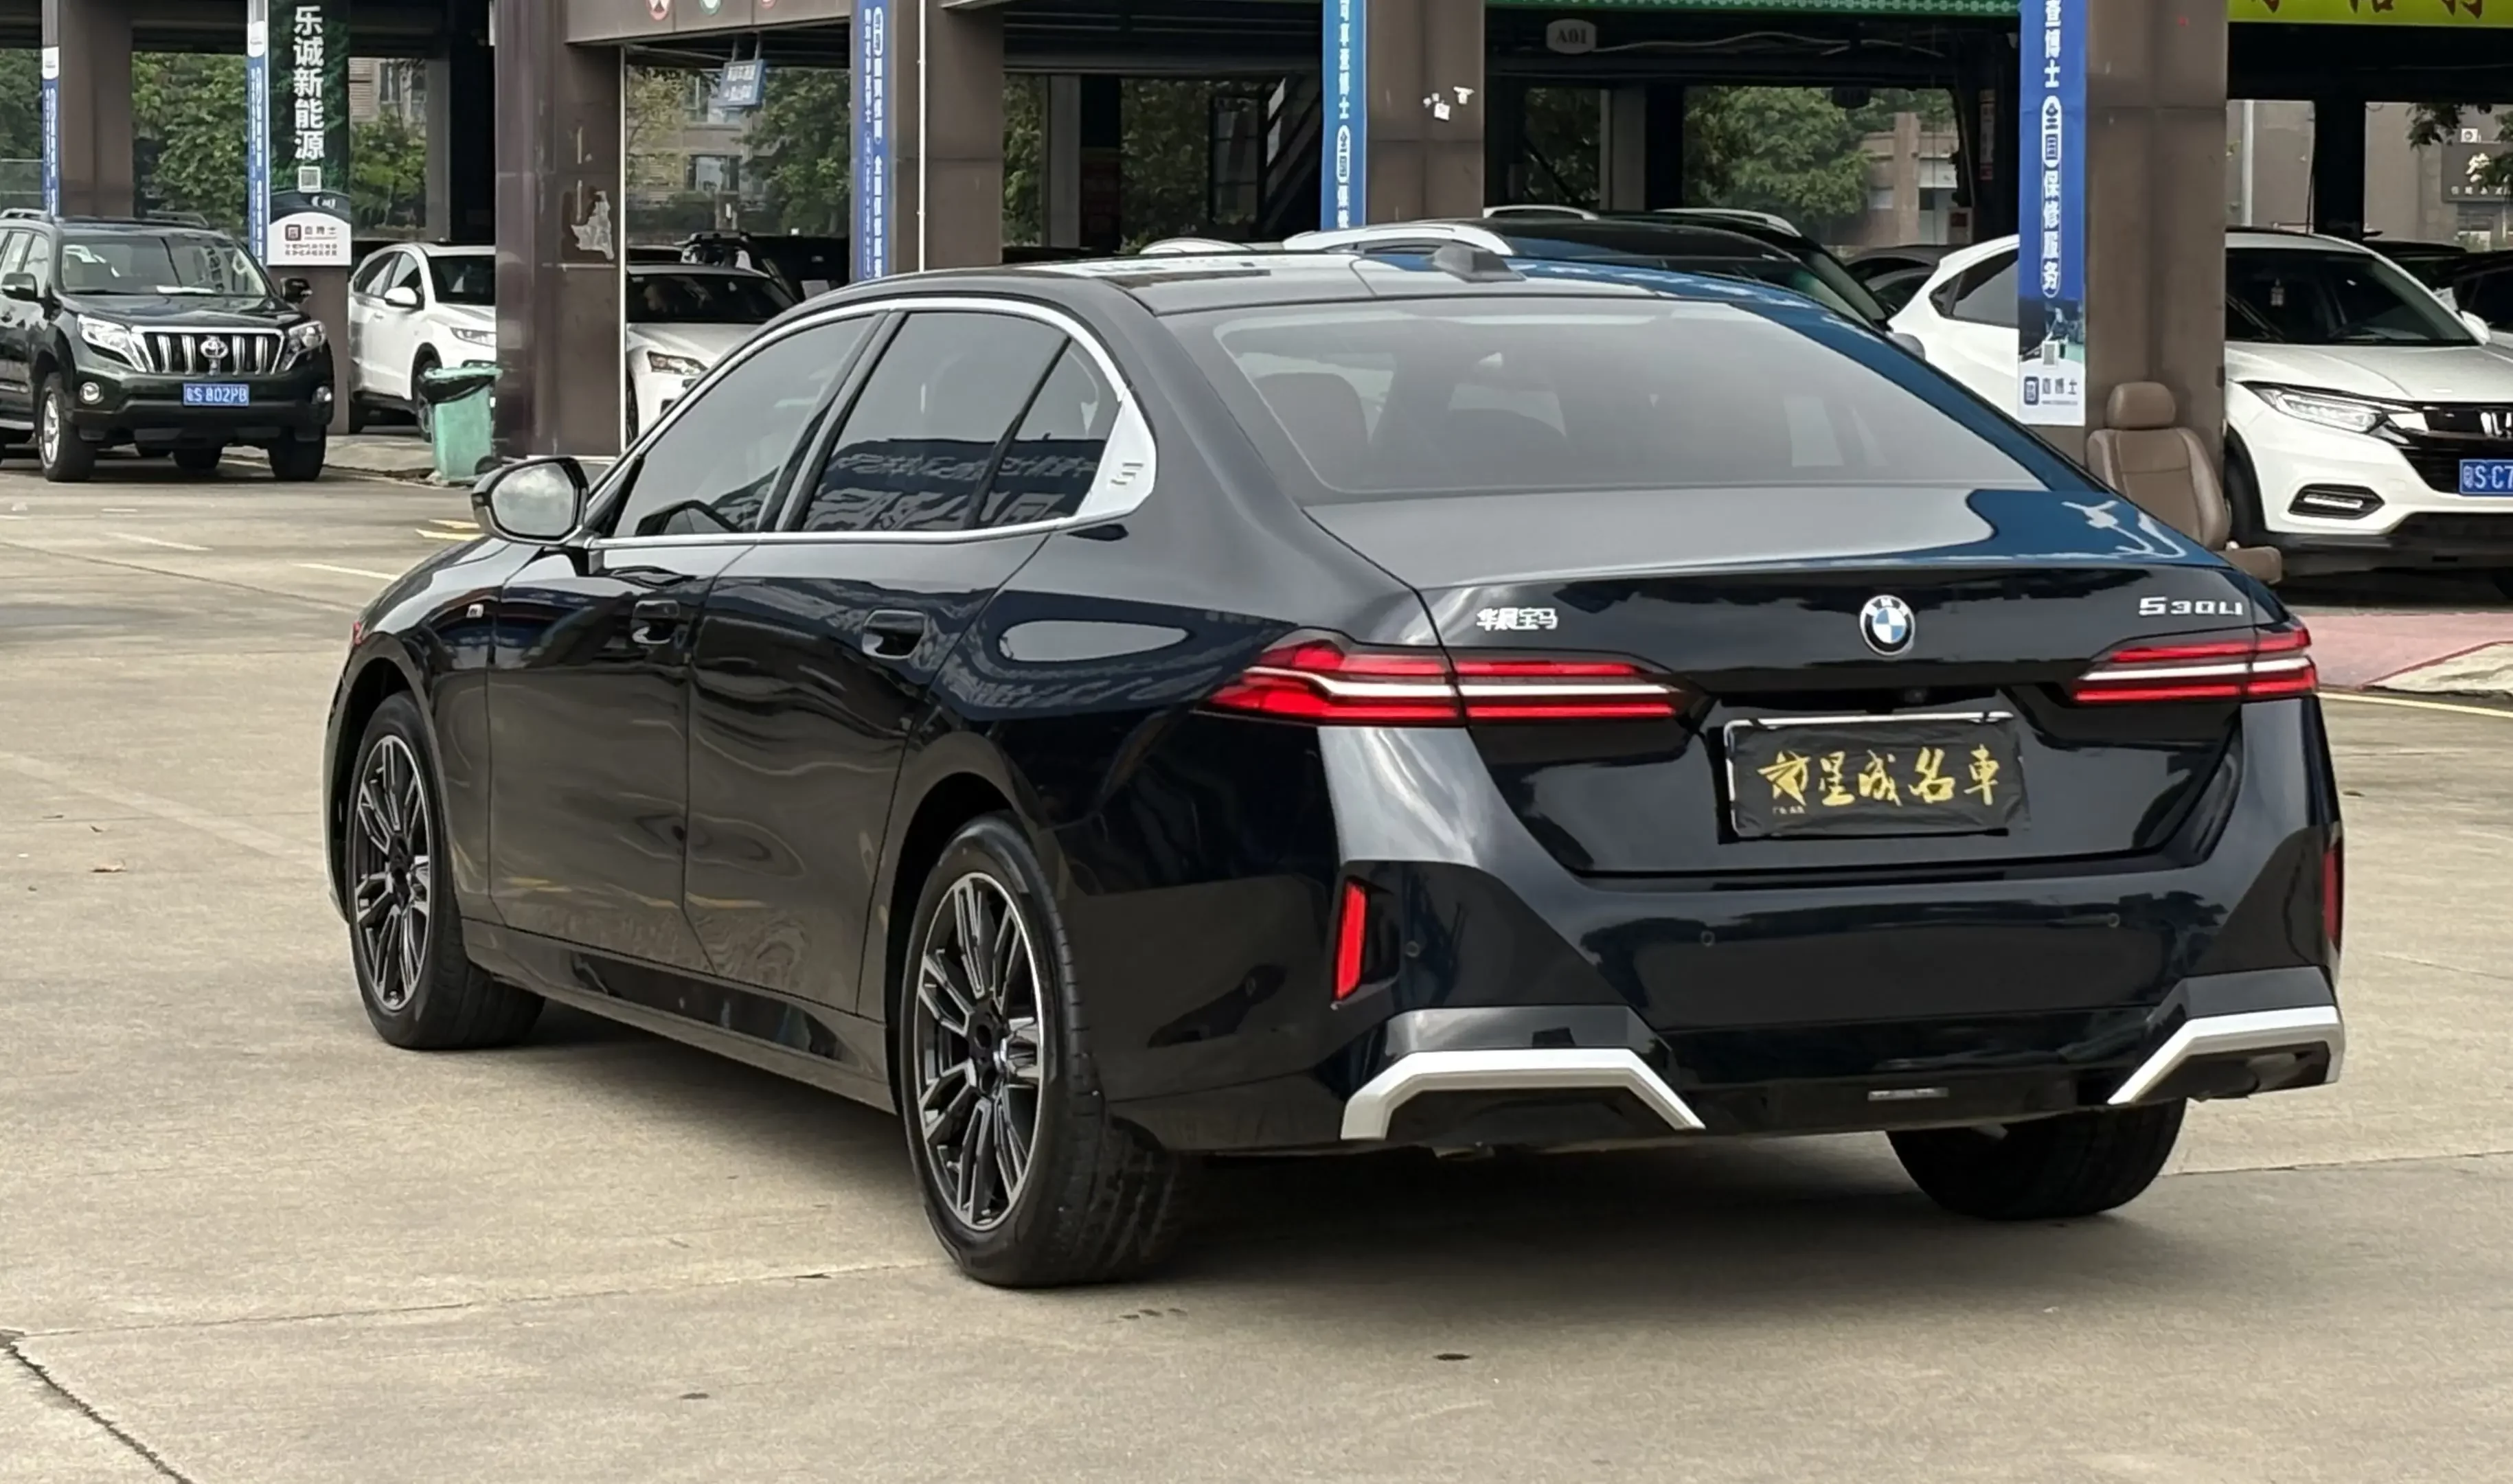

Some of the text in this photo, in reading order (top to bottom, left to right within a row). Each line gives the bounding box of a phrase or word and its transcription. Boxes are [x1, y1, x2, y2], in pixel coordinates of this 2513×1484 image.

[293, 5, 325, 159] 乐诚新能源
[1476, 607, 1558, 631] 华晨宝马
